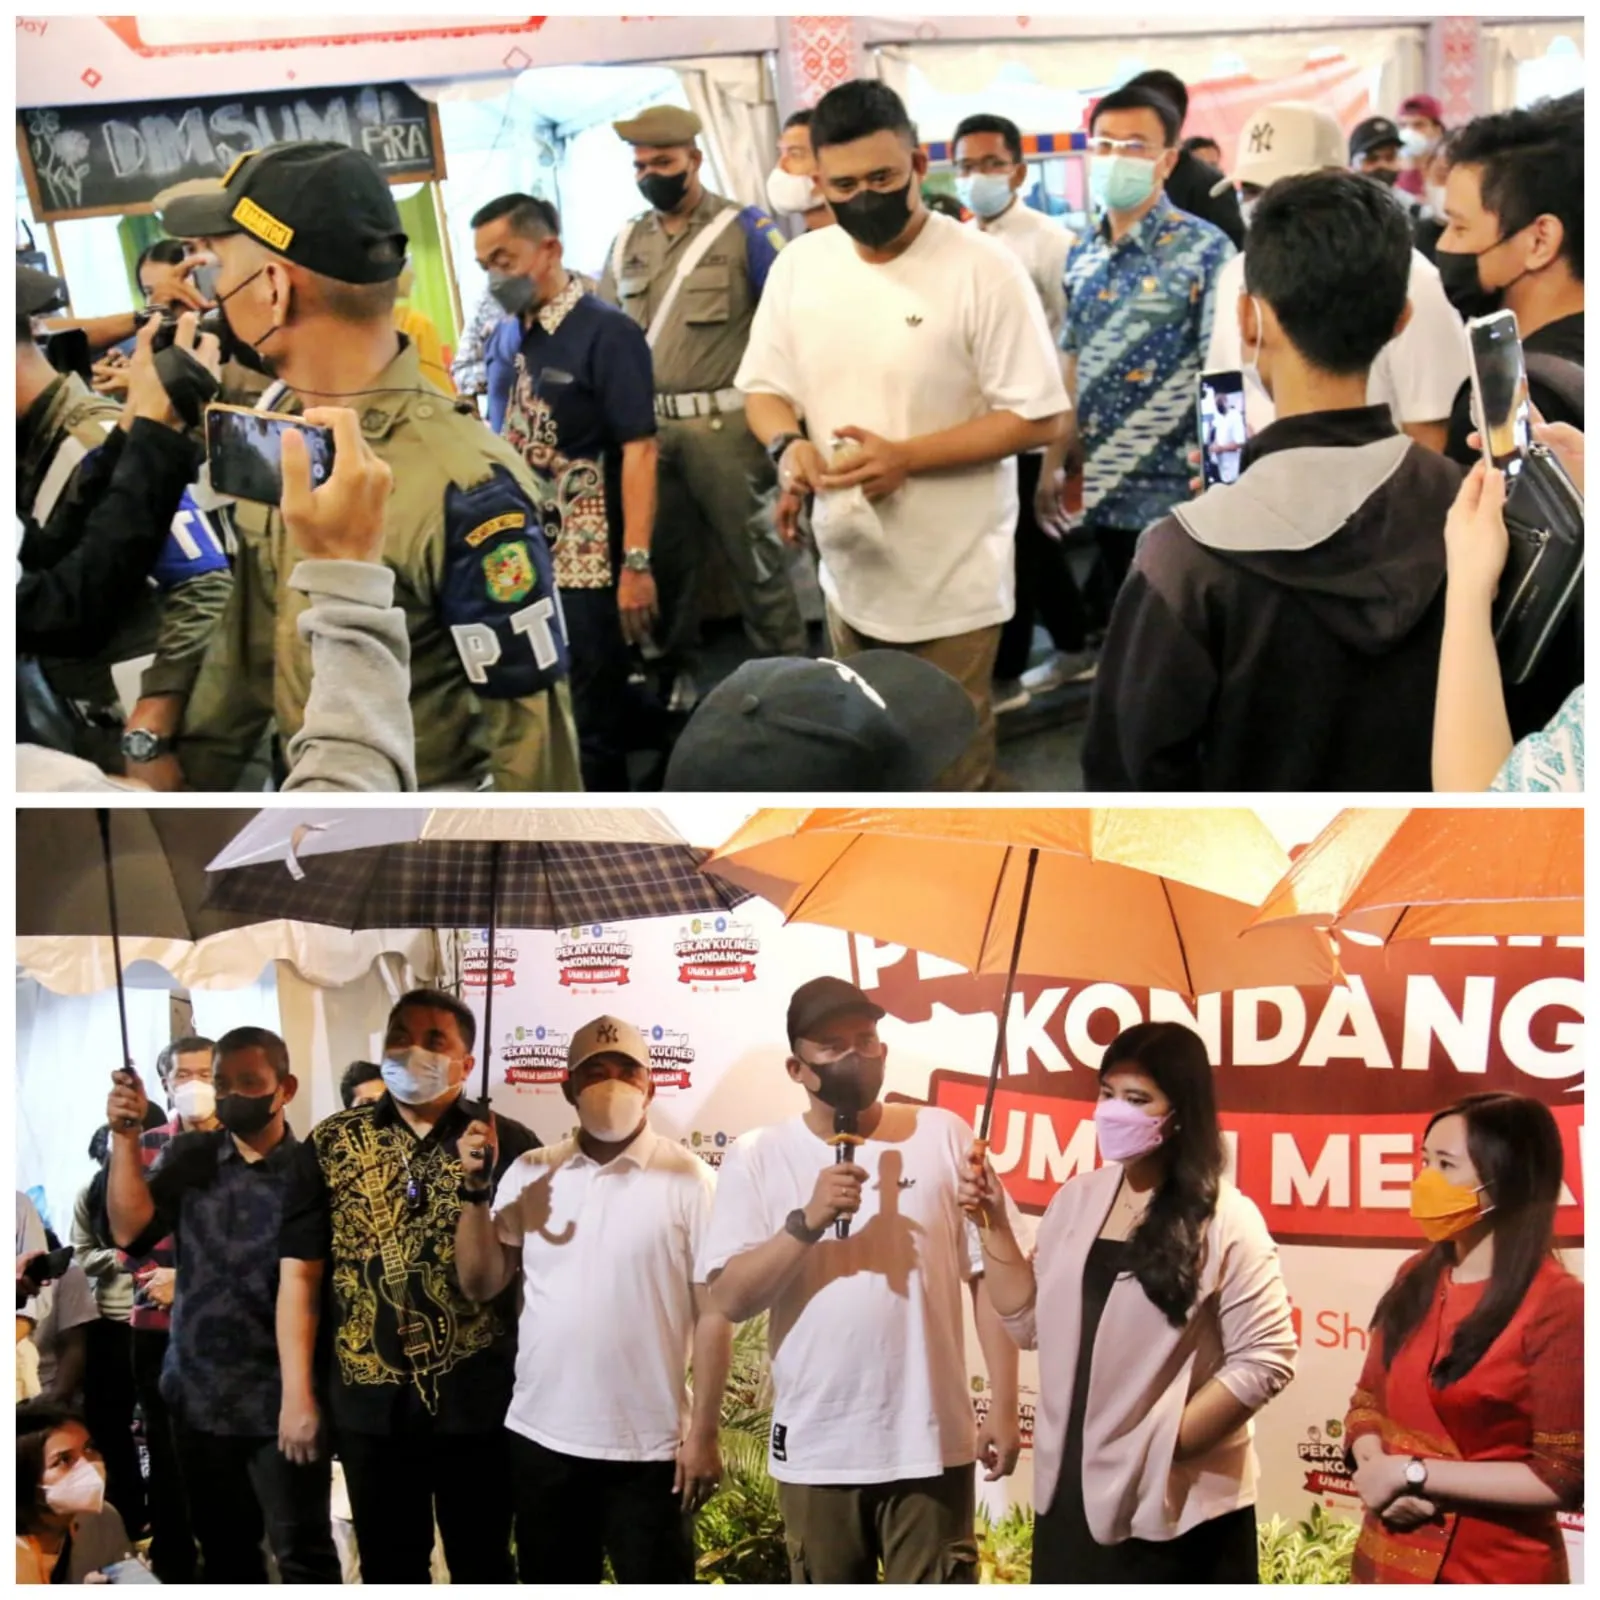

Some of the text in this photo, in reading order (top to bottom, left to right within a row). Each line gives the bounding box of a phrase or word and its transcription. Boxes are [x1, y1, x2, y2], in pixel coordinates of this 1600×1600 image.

[102, 97, 349, 178] DIMSUM
[534, 1046, 568, 1060] KULINE
[650, 1058, 679, 1069] DANG
[1314, 1310, 1366, 1351] Sh
[1298, 1443, 1343, 1459] PEKA
[1318, 1474, 1356, 1492] UMK
